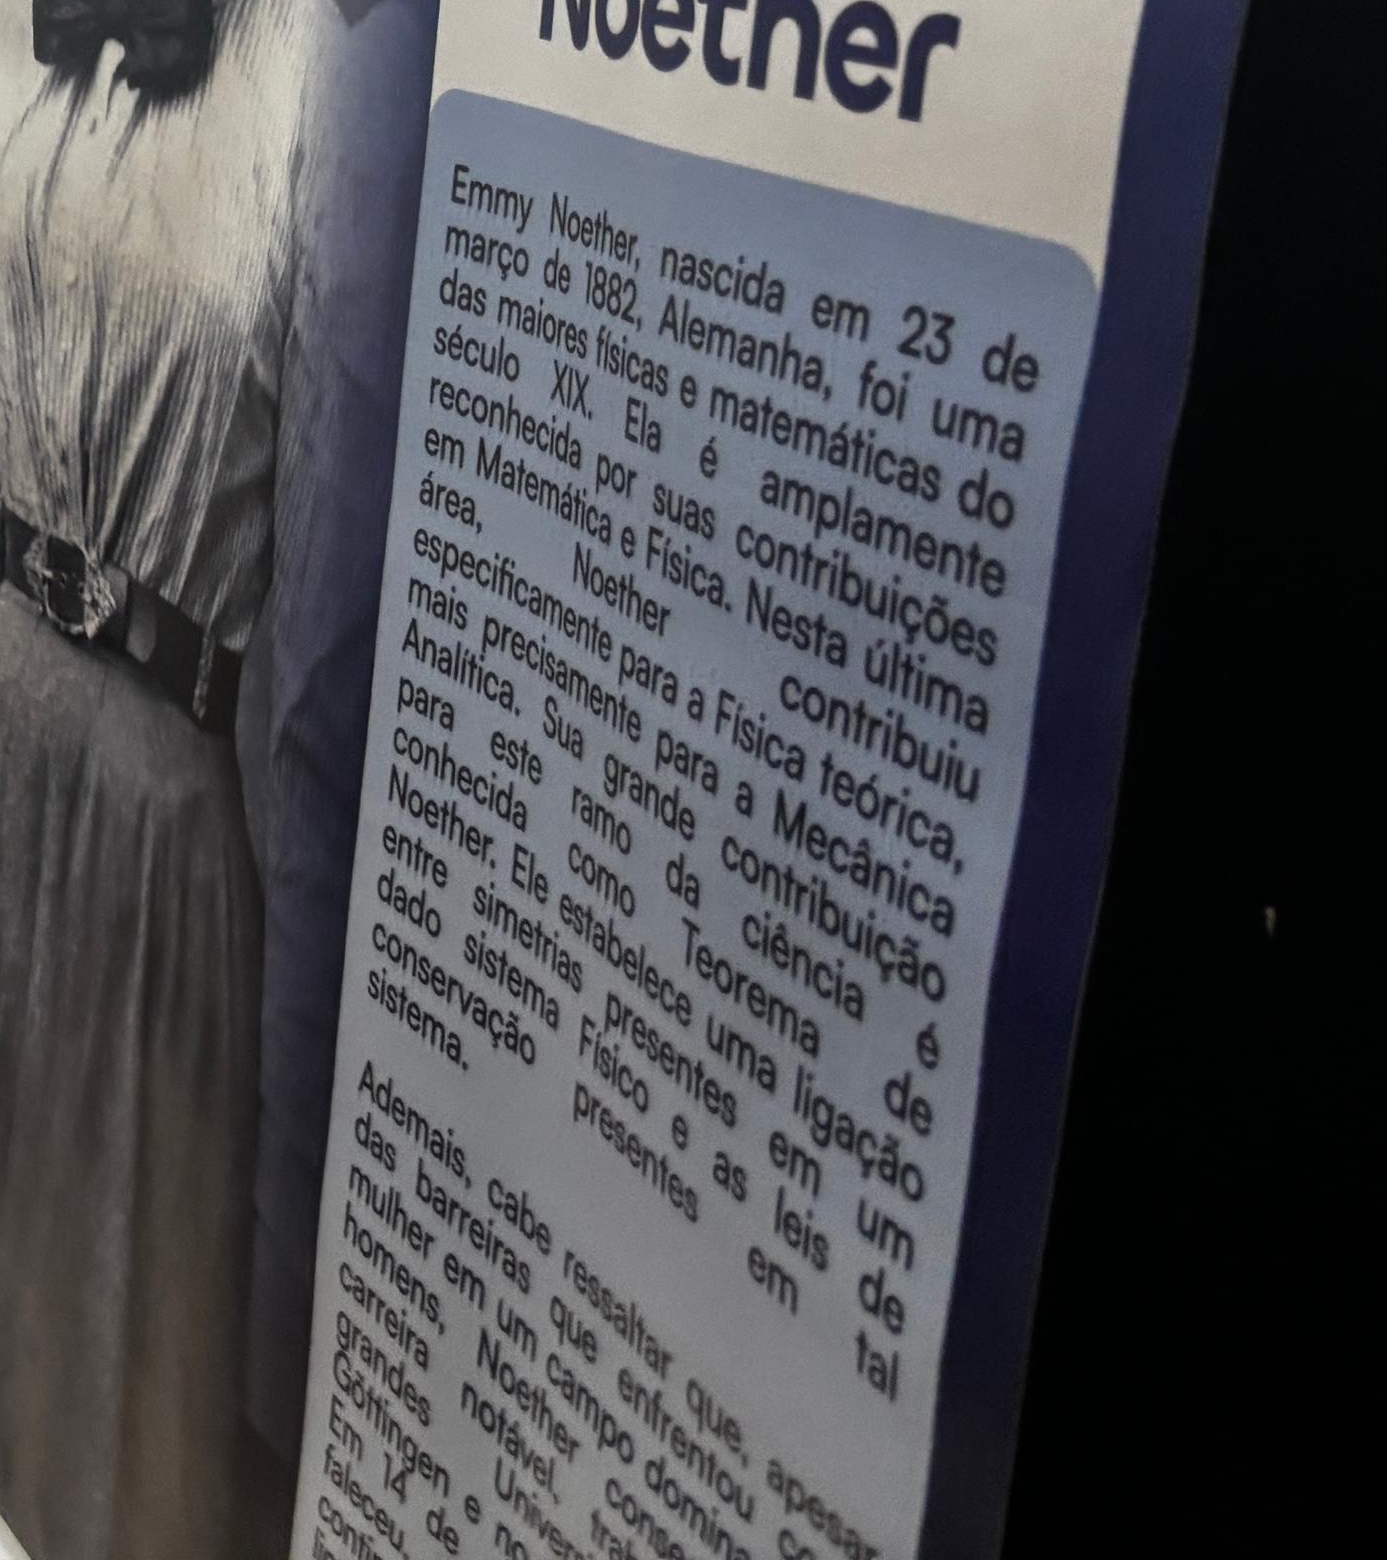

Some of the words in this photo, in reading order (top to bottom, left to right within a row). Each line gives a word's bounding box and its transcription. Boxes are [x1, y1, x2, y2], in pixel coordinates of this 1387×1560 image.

[439, 272, 487, 318] das
[497, 294, 589, 359] maiores
[595, 324, 669, 398] físicas
[680, 375, 697, 409] e
[710, 387, 942, 502] matemáticas
[959, 468, 1016, 530] do
[444, 222, 529, 280] março
[543, 256, 572, 294] de
[584, 263, 643, 332] 1882,
[658, 294, 832, 402] Alemanha,
[859, 359, 911, 421] foi
[931, 396, 1025, 462] uma
[451, 165, 533, 231] Emmy
[550, 192, 640, 272] Noether,
[660, 244, 786, 314] nascida
[812, 294, 870, 340] em
[897, 305, 955, 365] 23
[982, 332, 1040, 394] de
[425, 428, 465, 468] em
[476, 443, 612, 543] Matemática
[620, 526, 636, 558] e
[646, 526, 731, 614] Física.
[746, 578, 847, 669] Nesta
[864, 638, 990, 736] última
[429, 379, 582, 468] reconhecida
[596, 452, 638, 499] por
[653, 488, 716, 539] suas
[735, 523, 998, 667] contribuições
[433, 323, 521, 382] século
[550, 358, 593, 419] XIX.
[624, 398, 663, 454] Ela
[699, 438, 719, 478] é
[759, 468, 1006, 598] amplamente
[408, 576, 469, 632] mais
[482, 613, 641, 744] precisamente
[655, 729, 719, 795] para
[736, 781, 753, 817] a
[772, 794, 954, 938] Mecânica
[413, 527, 612, 663] especificamente
[620, 644, 678, 704] para
[687, 687, 704, 722] a
[715, 688, 806, 782] Física
[819, 753, 964, 874] teórica,
[419, 472, 483, 533] área,
[573, 542, 670, 637] Noether
[780, 674, 980, 803] contribuiu
[393, 725, 528, 832] conhecida
[567, 842, 636, 918] como
[679, 917, 821, 1059] Teorema
[883, 1070, 933, 1135] de
[397, 673, 455, 731] para
[490, 727, 543, 785] este
[571, 782, 631, 856] ramo
[665, 853, 702, 910] da
[741, 910, 866, 1023] ciência
[916, 1019, 940, 1070] é
[401, 618, 522, 716] Analítica.
[542, 697, 584, 761] Sua
[603, 750, 697, 840] grande
[720, 834, 946, 1003] contribuição
[368, 968, 470, 1073] sistema.
[377, 869, 442, 938] dado
[463, 932, 561, 1031] sistema
[578, 1013, 650, 1115] Físico
[671, 1114, 689, 1151] e
[712, 1149, 748, 1205] as
[772, 1188, 829, 1273] leis
[857, 1266, 905, 1337] de
[382, 823, 448, 889] entre
[472, 884, 584, 995] simetrias
[604, 988, 738, 1130] presentes
[768, 1131, 822, 1197] em
[855, 1196, 916, 1273] um
[387, 764, 497, 871] Noether.
[510, 843, 550, 906] Ele
[560, 890, 693, 1028] estabelece
[705, 1013, 779, 1093] uma
[792, 1065, 925, 1204] ligação
[348, 1161, 435, 1261] mulher
[444, 1251, 485, 1310] em
[497, 1296, 538, 1363] um
[546, 1351, 635, 1465] campo
[358, 1059, 473, 1189] Ademais,
[486, 1175, 552, 1258] cabe
[562, 1248, 674, 1381] ressaltar
[686, 1378, 749, 1469] que,
[372, 921, 537, 1067] conservação
[573, 1081, 699, 1224] presentes
[748, 1244, 799, 1317] em
[855, 1331, 898, 1403] tal
[333, 1349, 450, 1499] Göttingen
[464, 1494, 481, 1525] e
[335, 1309, 432, 1427] grandes
[494, 1456, 593, 1560] Univer
[339, 1260, 430, 1371] carreira
[461, 1381, 561, 1506] notável,
[343, 1200, 447, 1336] homens,
[478, 1327, 580, 1464] Noether
[354, 1112, 397, 1175] das
[417, 1158, 530, 1294] barreiras
[549, 1292, 599, 1365] que
[618, 1367, 754, 1524] enfrentou
[329, 1393, 362, 1462] Em
[383, 1451, 407, 1504] 14
[426, 1506, 460, 1556] de
